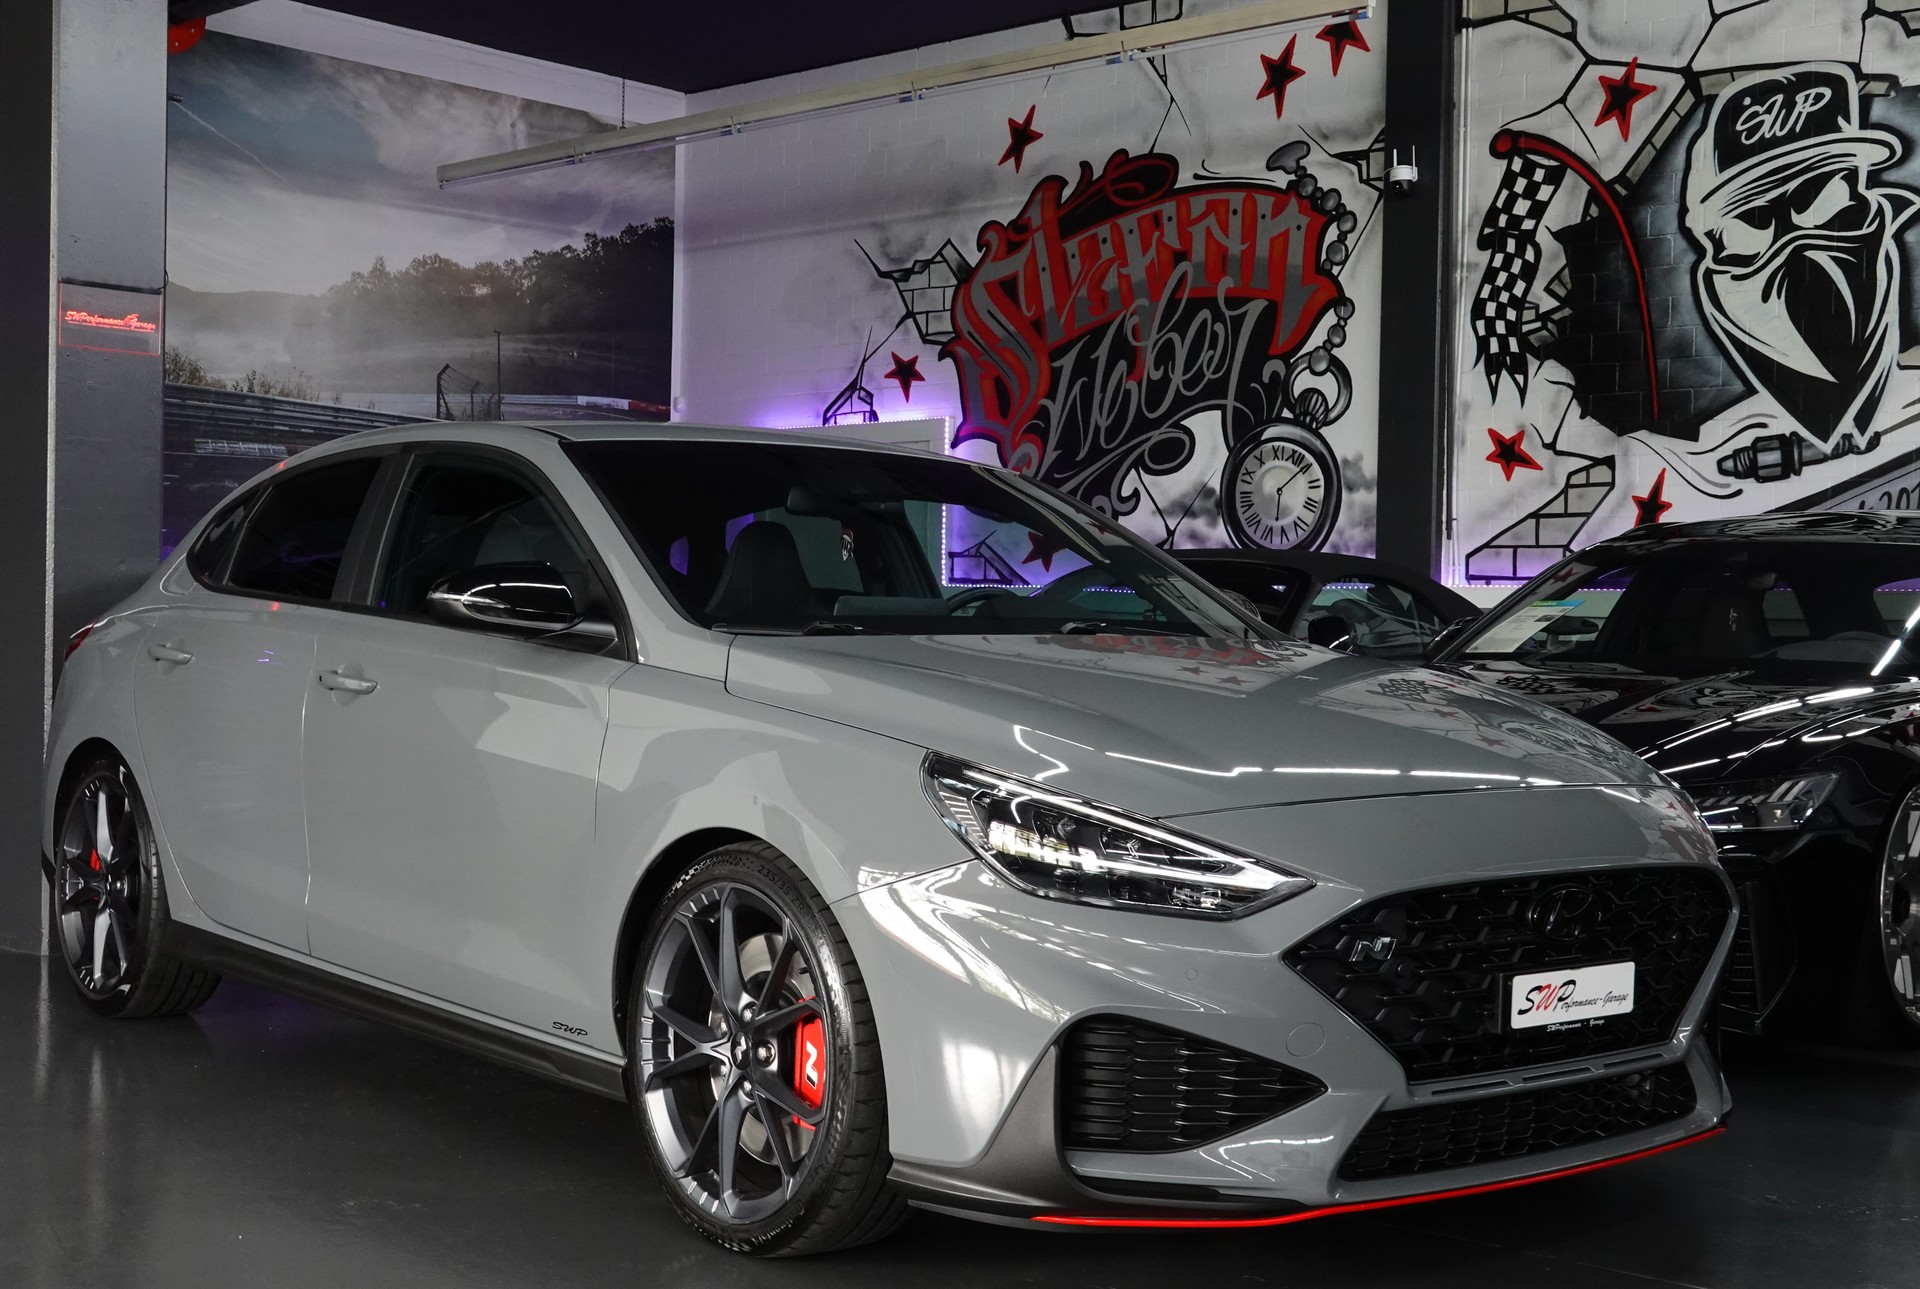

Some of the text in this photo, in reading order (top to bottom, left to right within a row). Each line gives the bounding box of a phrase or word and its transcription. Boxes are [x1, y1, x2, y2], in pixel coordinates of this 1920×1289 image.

[1736, 87, 1832, 145] SWP
[1349, 937, 1396, 961] N
[552, 1021, 588, 1036] SWP
